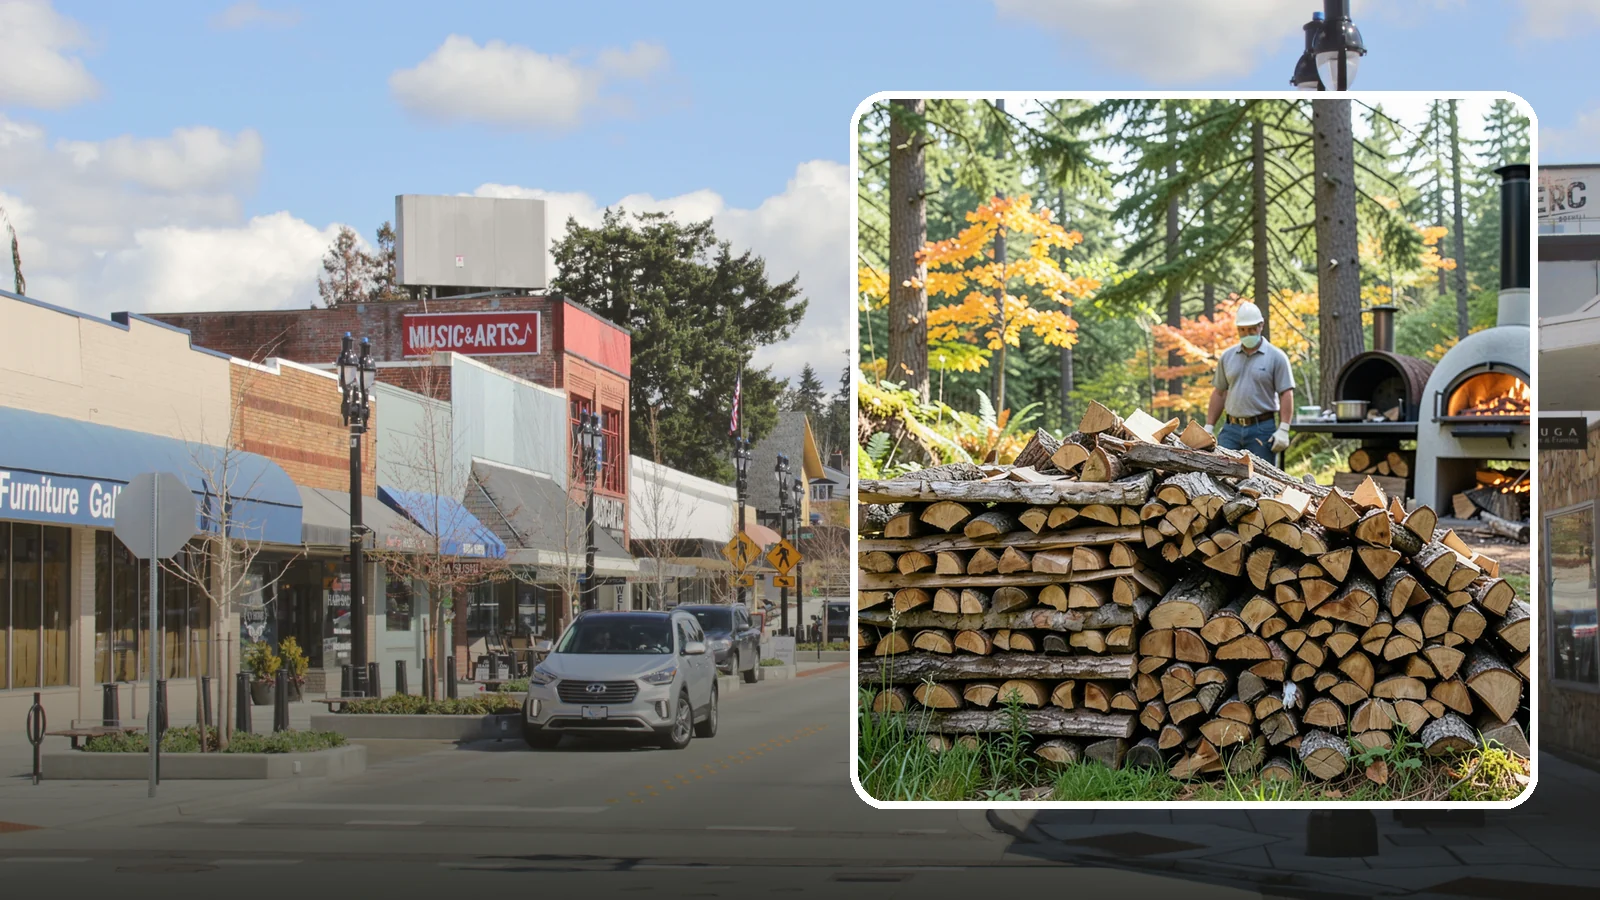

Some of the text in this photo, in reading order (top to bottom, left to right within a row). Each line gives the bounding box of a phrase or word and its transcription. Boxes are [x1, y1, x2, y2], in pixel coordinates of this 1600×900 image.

[1552, 436, 1579, 445] Framing
[0, 470, 122, 519] Furniture Gal
[453, 563, 479, 574] SUSHI
